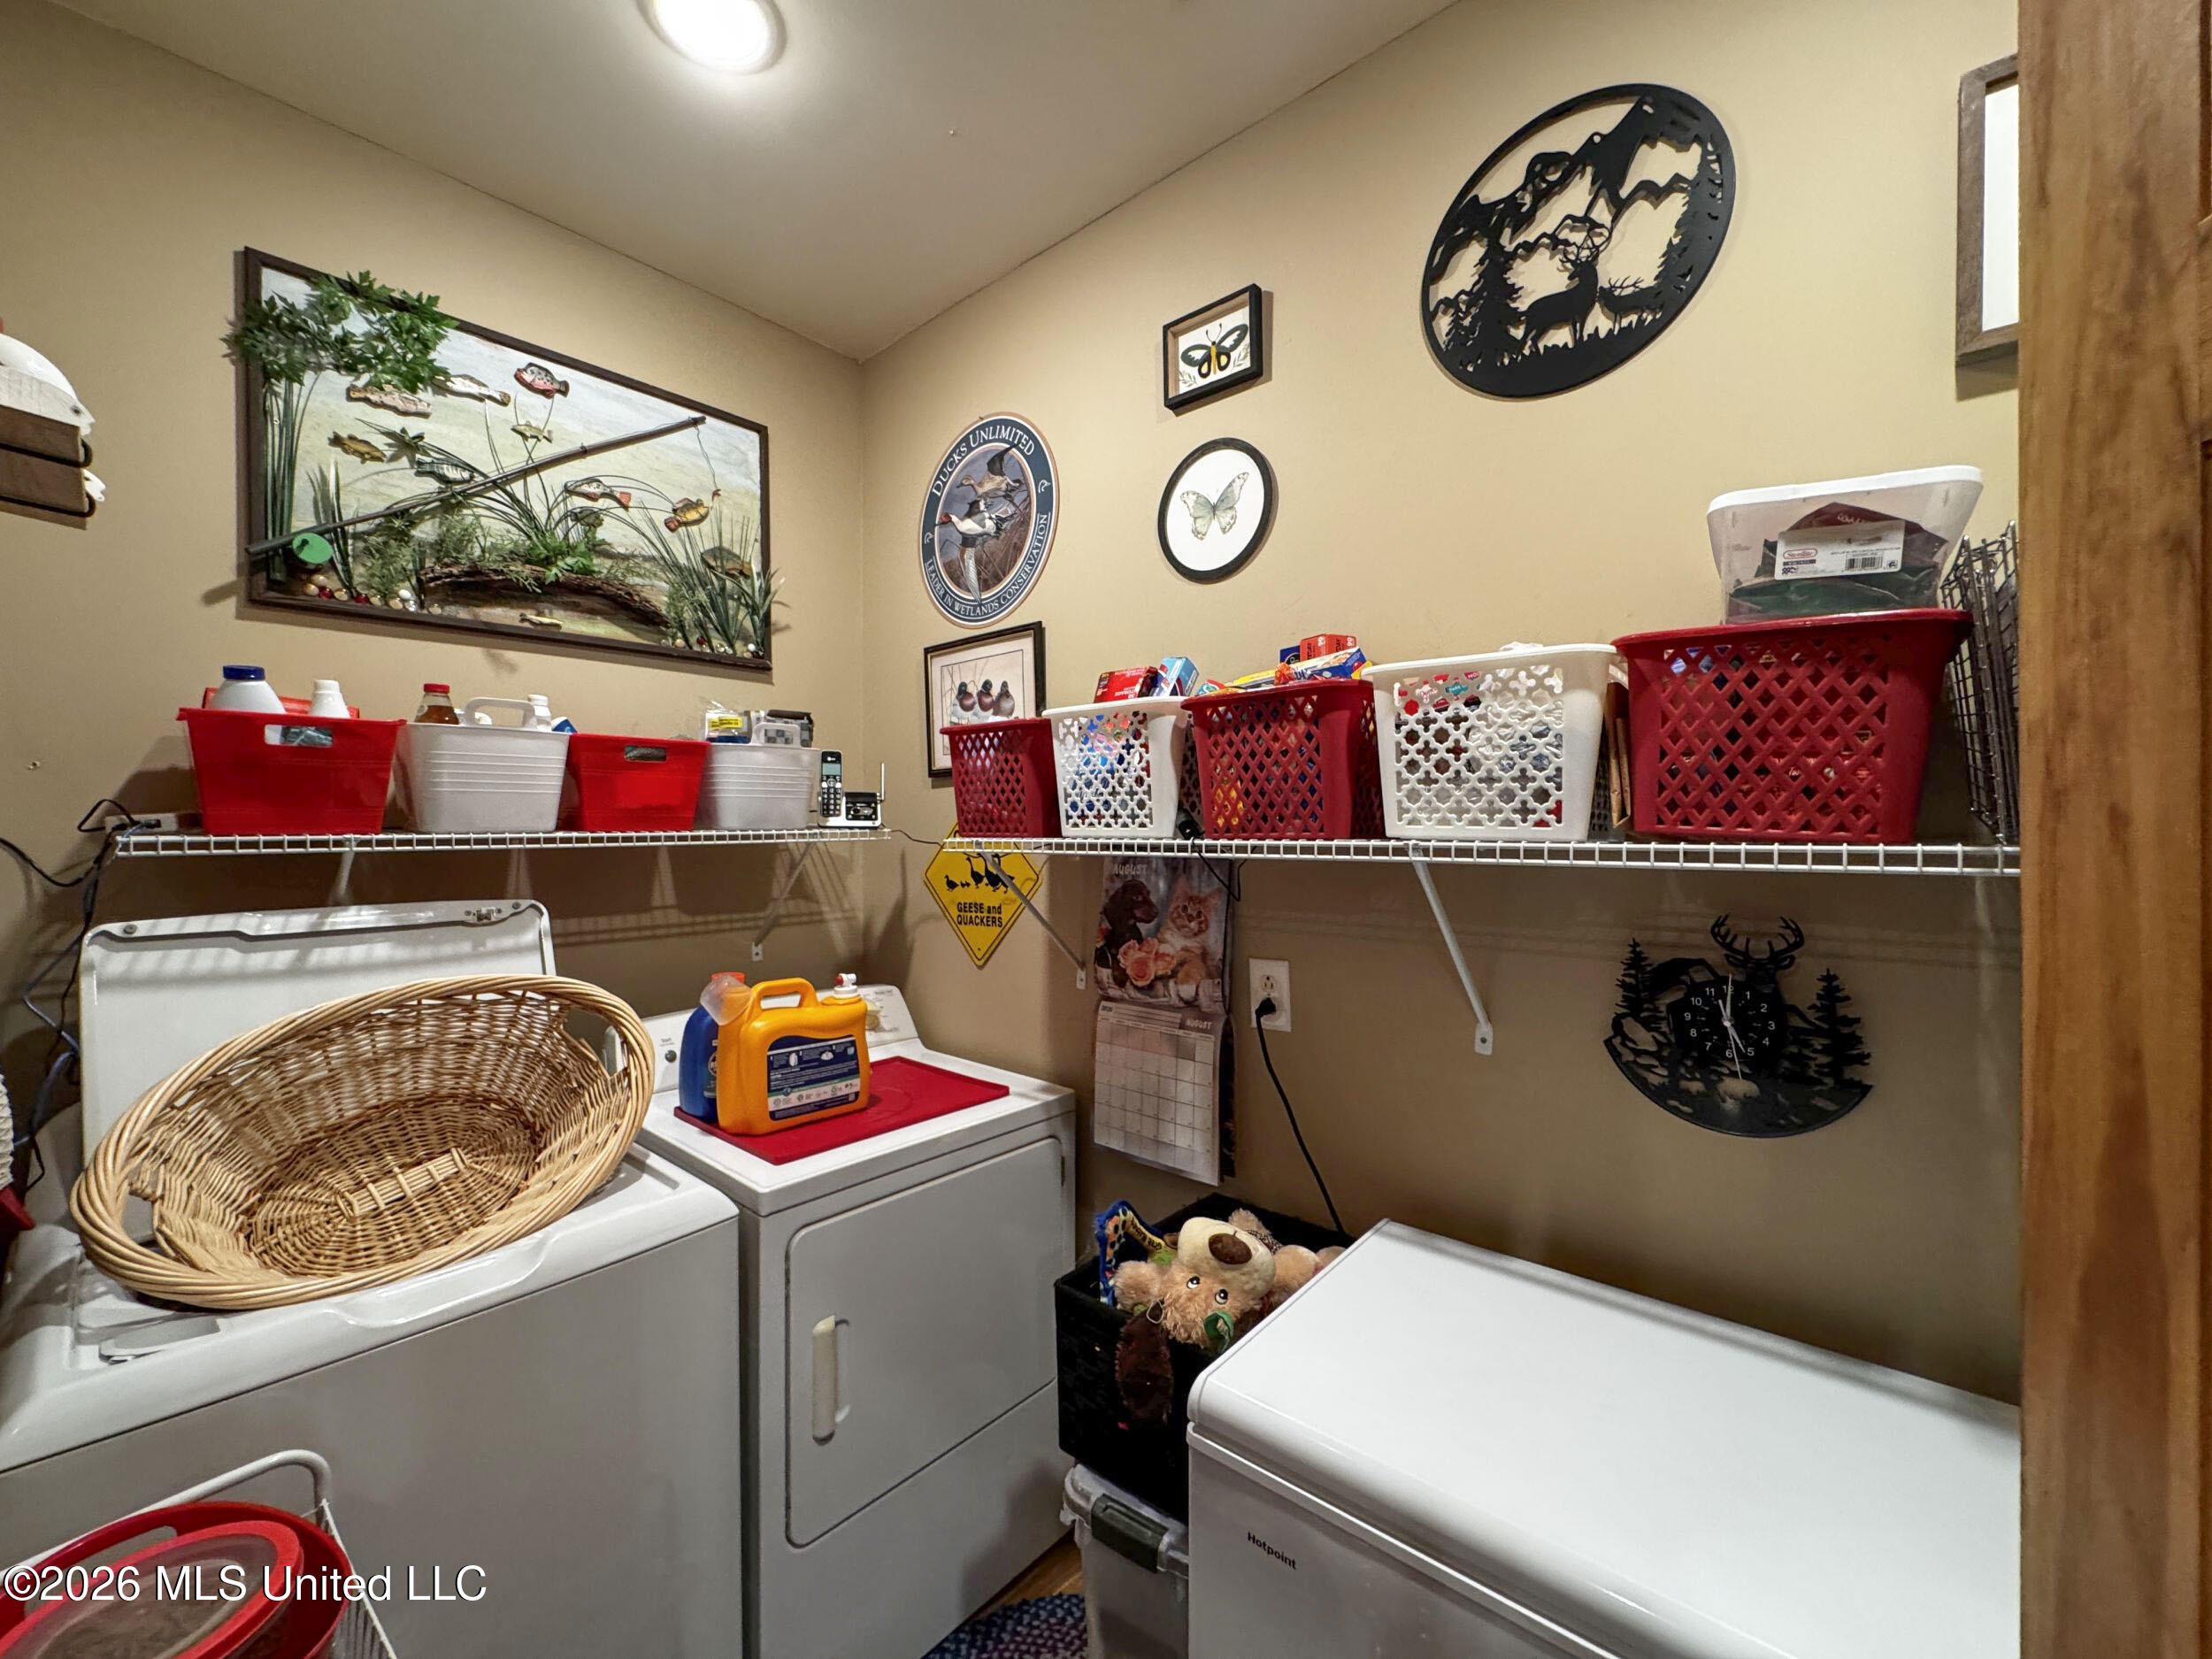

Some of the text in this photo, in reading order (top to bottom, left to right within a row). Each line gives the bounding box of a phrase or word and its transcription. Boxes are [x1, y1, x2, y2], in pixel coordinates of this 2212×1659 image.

[932, 425, 1035, 497] DUCKS UNLIMITED
[926, 514, 1048, 617] LEADER IN WETLANDS CONSERVATION
[1112, 864, 1148, 876] AUGUST
[957, 902, 1002, 915] GEESE and
[956, 916, 1003, 928] QUACKERS
[1705, 987, 1715, 996] 11
[1745, 990, 1750, 1000] 1
[1690, 997, 1702, 1006] 10
[1760, 1003, 1768, 1012] 2
[1684, 1012, 1691, 1021] 9
[1185, 1018, 1212, 1030] AUGUST
[1768, 1021, 1775, 1030] 3
[1690, 1028, 1697, 1037] 8
[1705, 1041, 1712, 1051] 7
[1762, 1037, 1770, 1048] 4
[1725, 1049, 1732, 1058] 6
[1747, 1048, 1755, 1056] 5
[1247, 1532, 1296, 1571] Hotpoint
